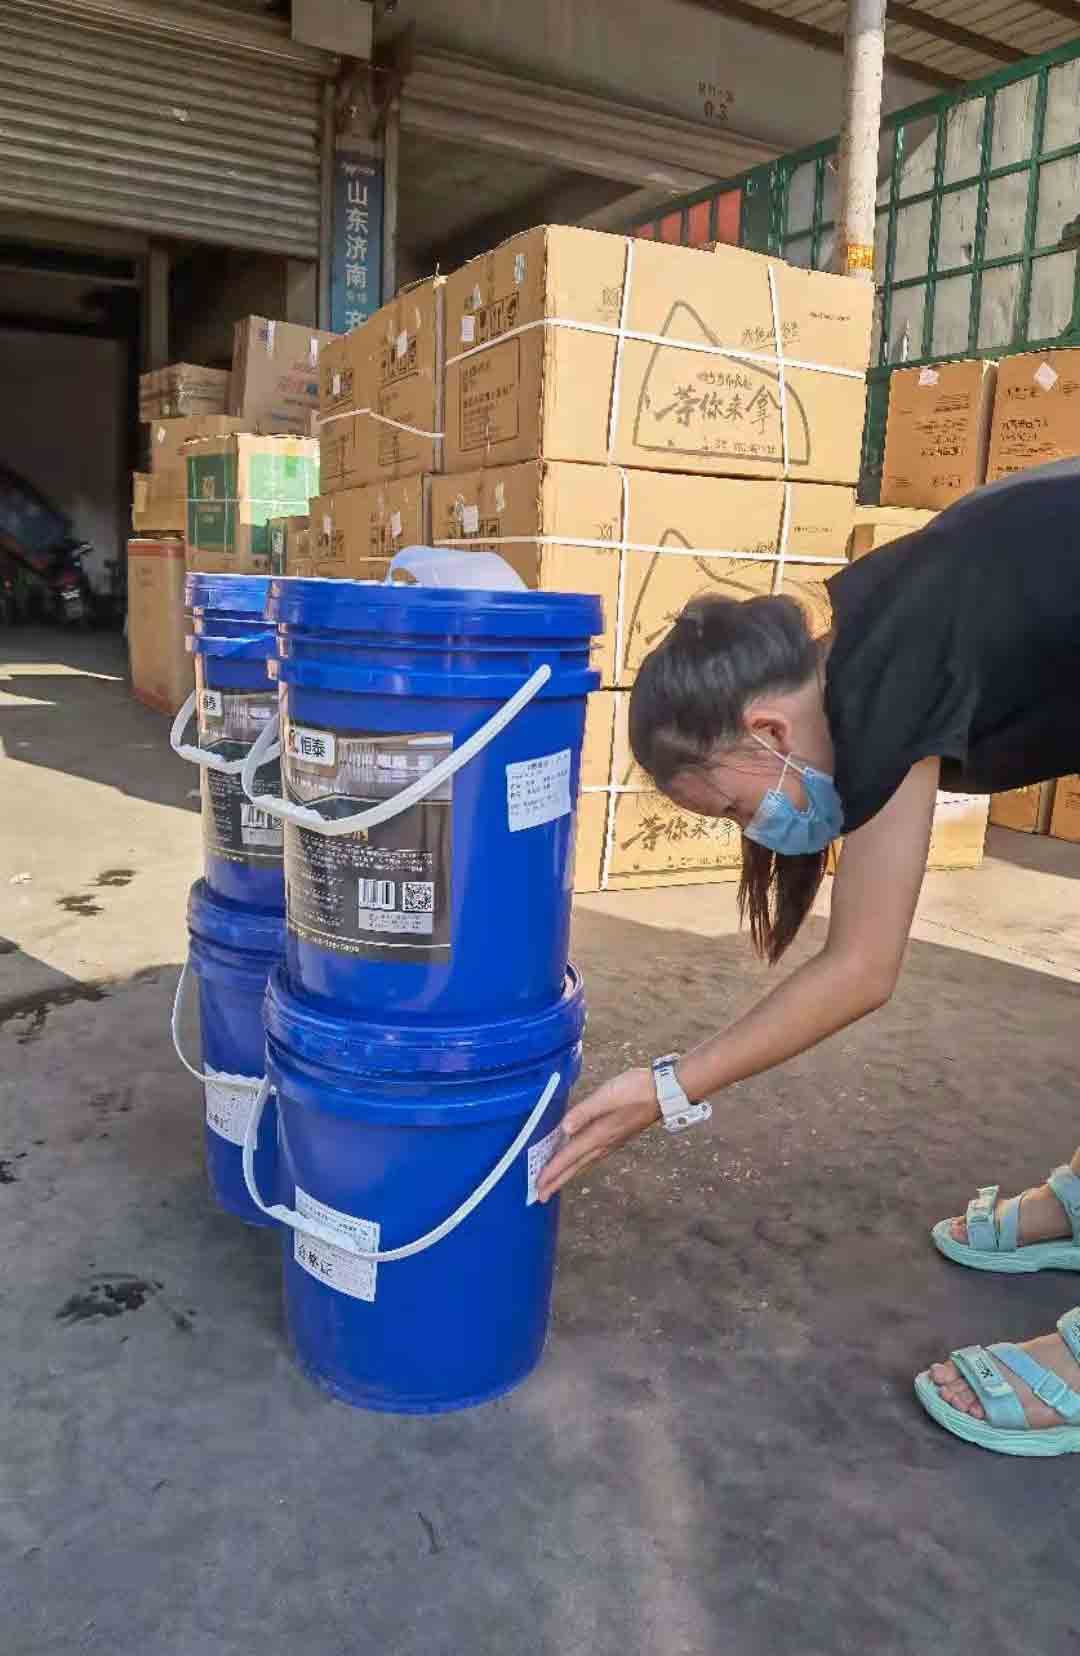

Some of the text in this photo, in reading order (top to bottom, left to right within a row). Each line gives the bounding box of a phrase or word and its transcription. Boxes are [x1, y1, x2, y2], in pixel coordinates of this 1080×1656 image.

[345, 180, 369, 289] 山东济南
[654, 383, 782, 435] 等你来拿
[300, 735, 326, 758] 恒泰
